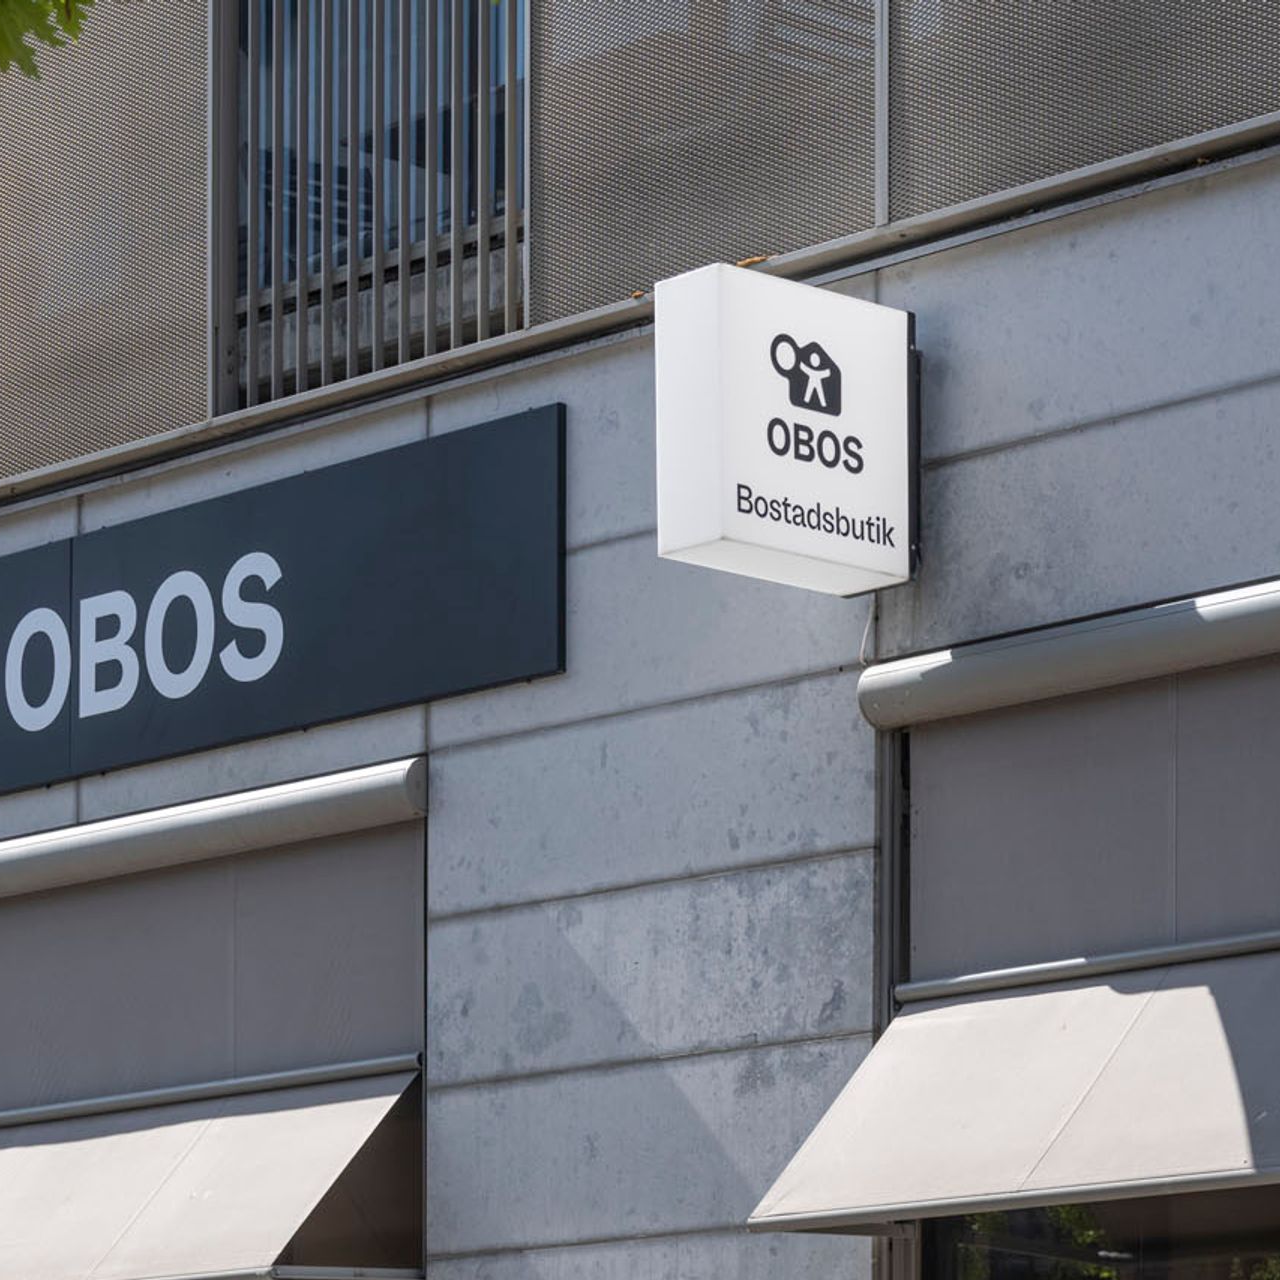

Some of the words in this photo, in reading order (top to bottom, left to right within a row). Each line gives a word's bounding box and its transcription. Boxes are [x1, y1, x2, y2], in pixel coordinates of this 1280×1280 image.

[767, 417, 864, 474] OBOS
[736, 483, 896, 548] Bostadsbutik
[5, 551, 284, 732] OBOS
